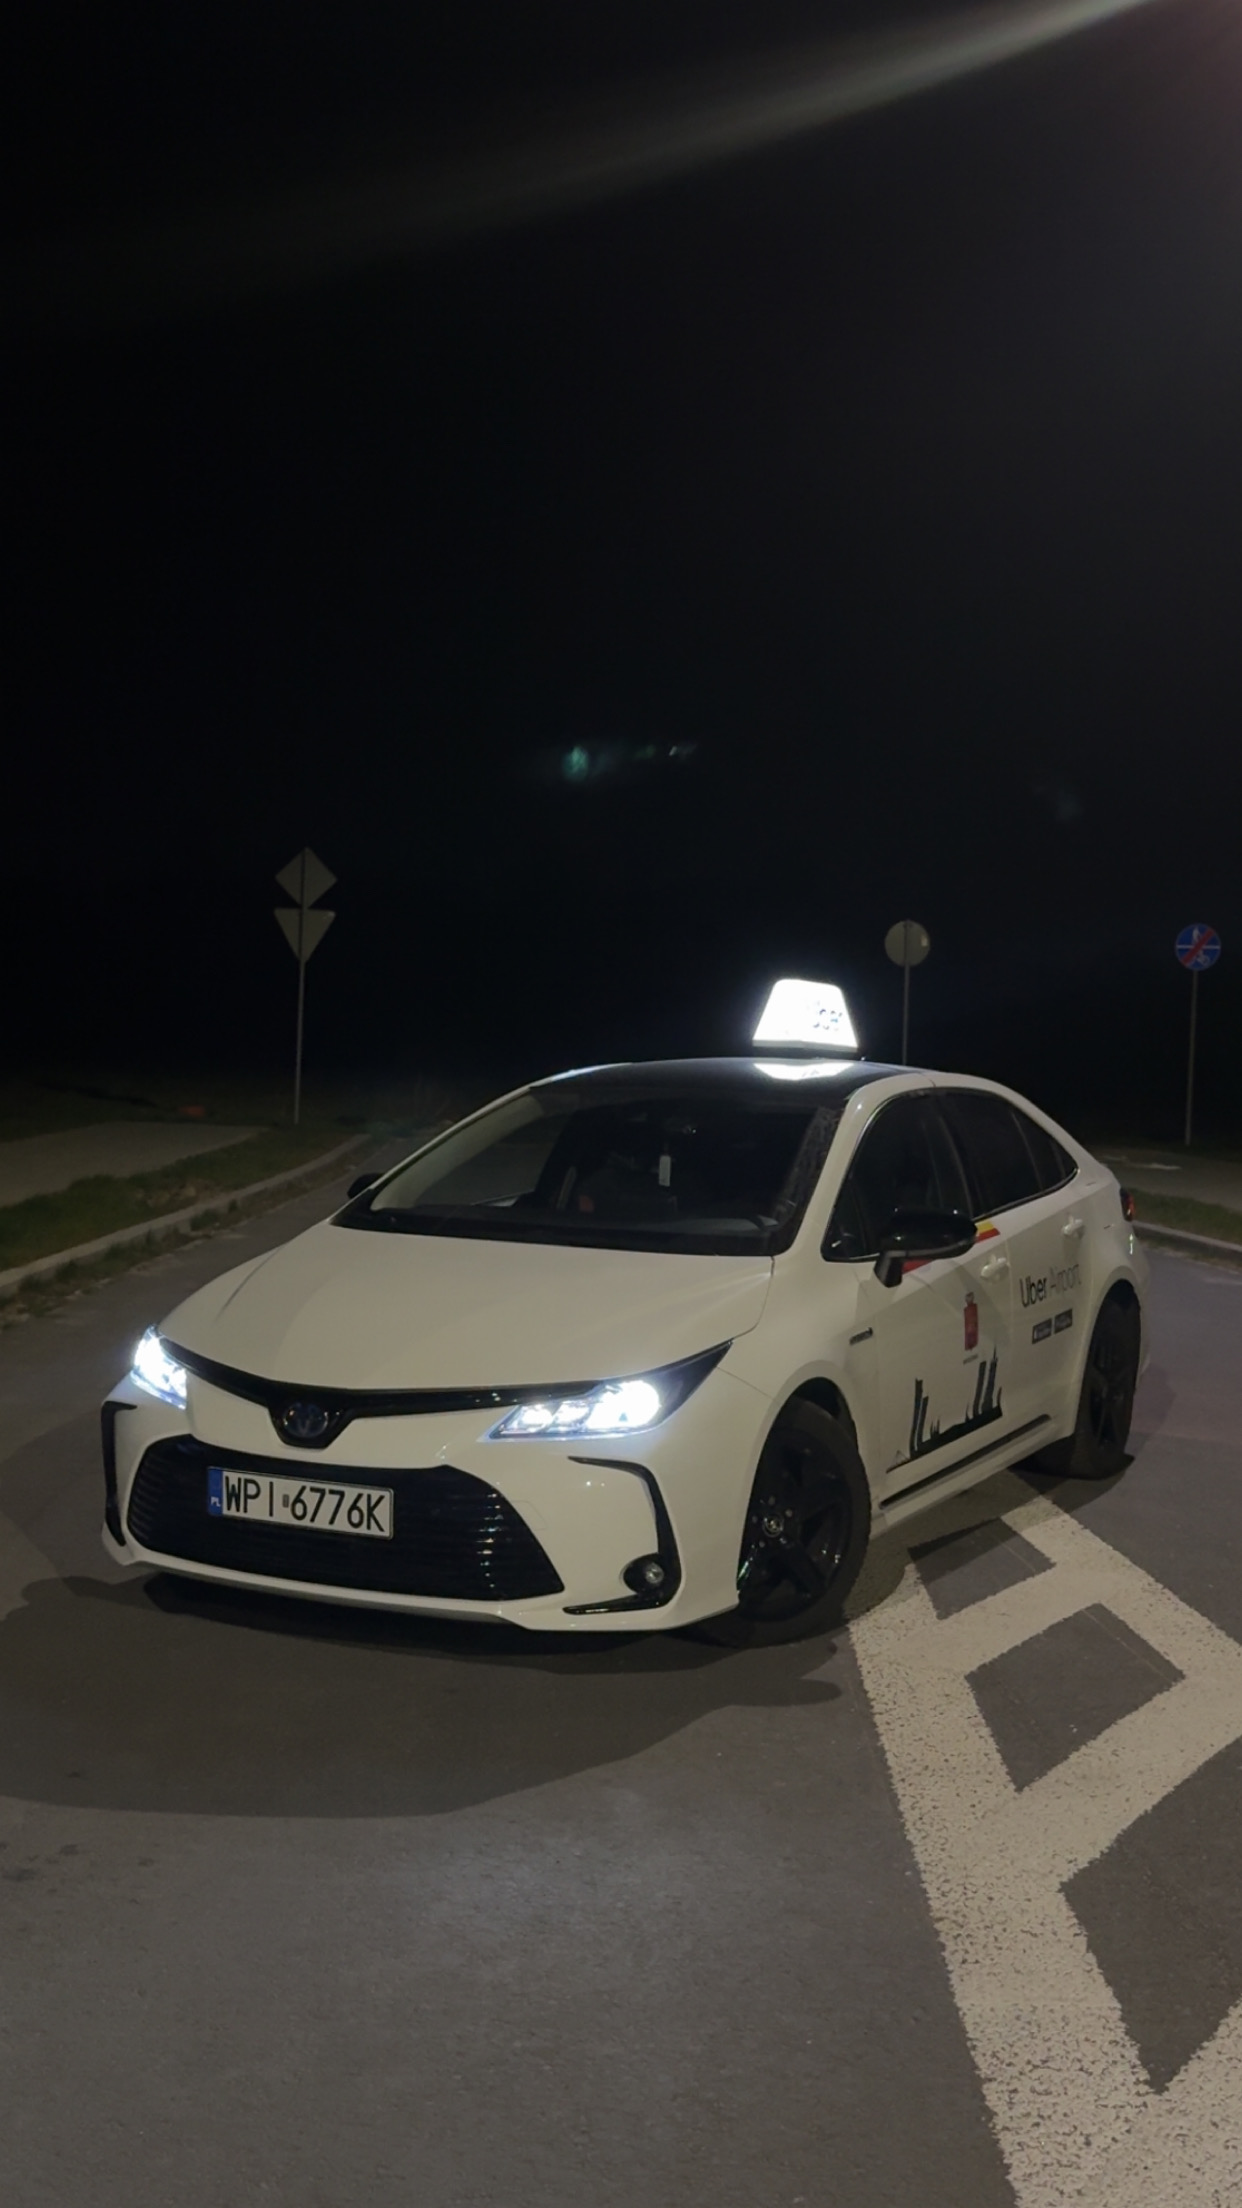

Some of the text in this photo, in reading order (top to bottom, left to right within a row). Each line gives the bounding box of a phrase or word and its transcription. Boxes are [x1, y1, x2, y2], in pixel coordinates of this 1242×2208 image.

[1019, 1275, 1047, 1308] Uber
[225, 1475, 385, 1532] WPI 6776K
